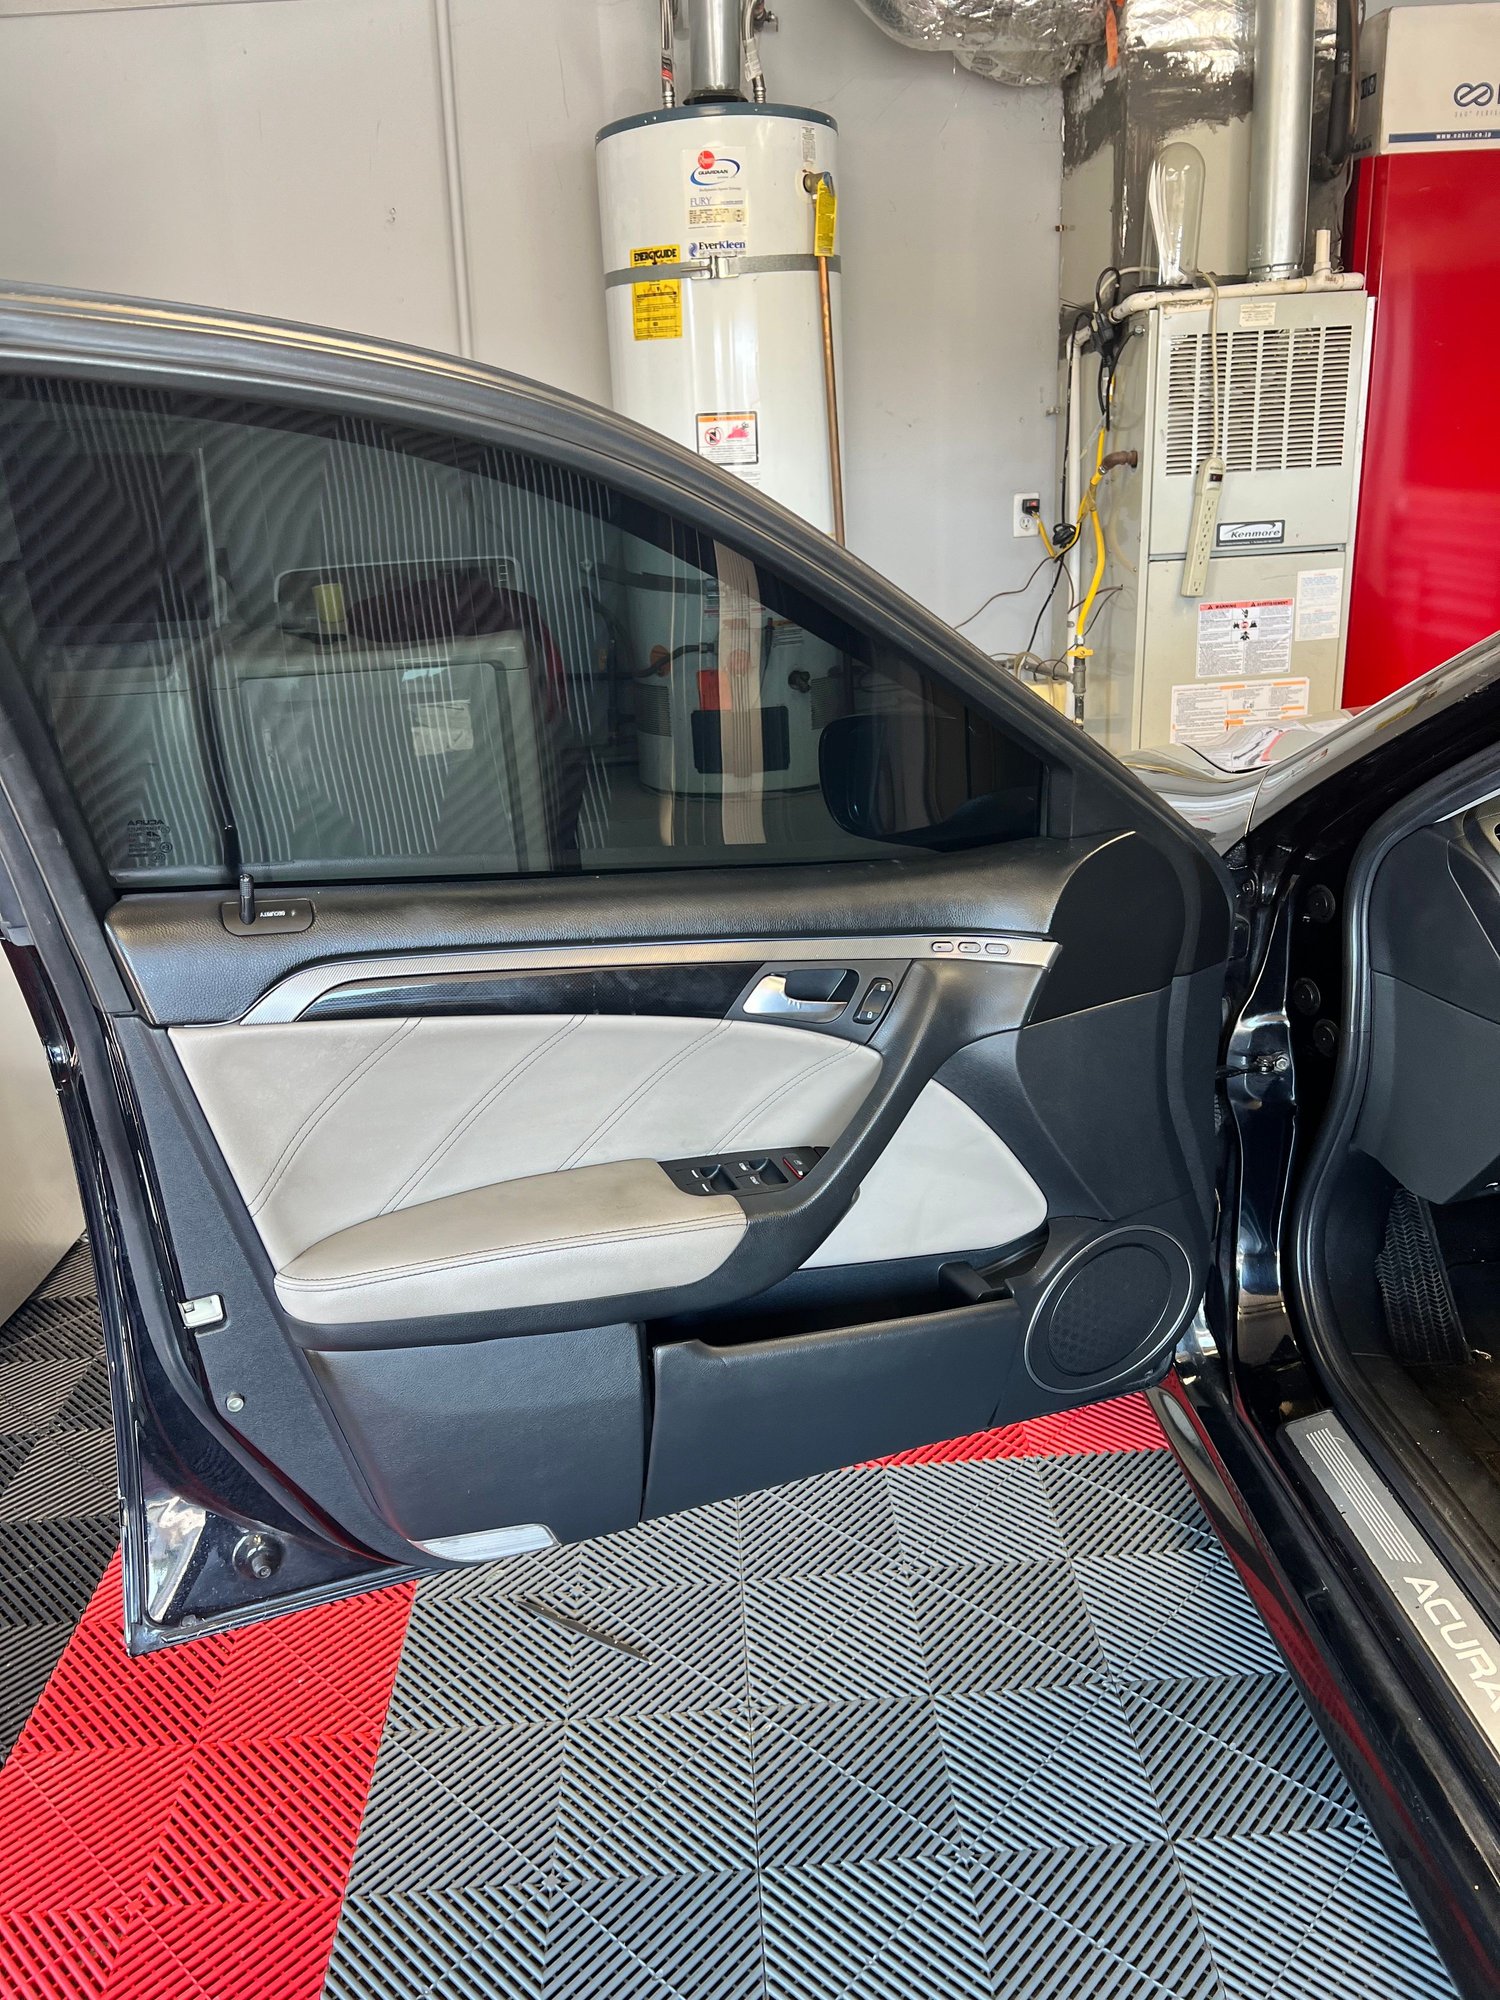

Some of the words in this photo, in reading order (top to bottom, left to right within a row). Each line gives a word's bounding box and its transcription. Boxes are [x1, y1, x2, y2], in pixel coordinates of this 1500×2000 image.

[1436, 131, 1492, 140] www.enkei.co.jp
[690, 196, 712, 206] FURY
[699, 240, 746, 250] EverKleen
[1230, 529, 1280, 539] Kenmore
[1403, 1576, 1500, 1713] ACURA
